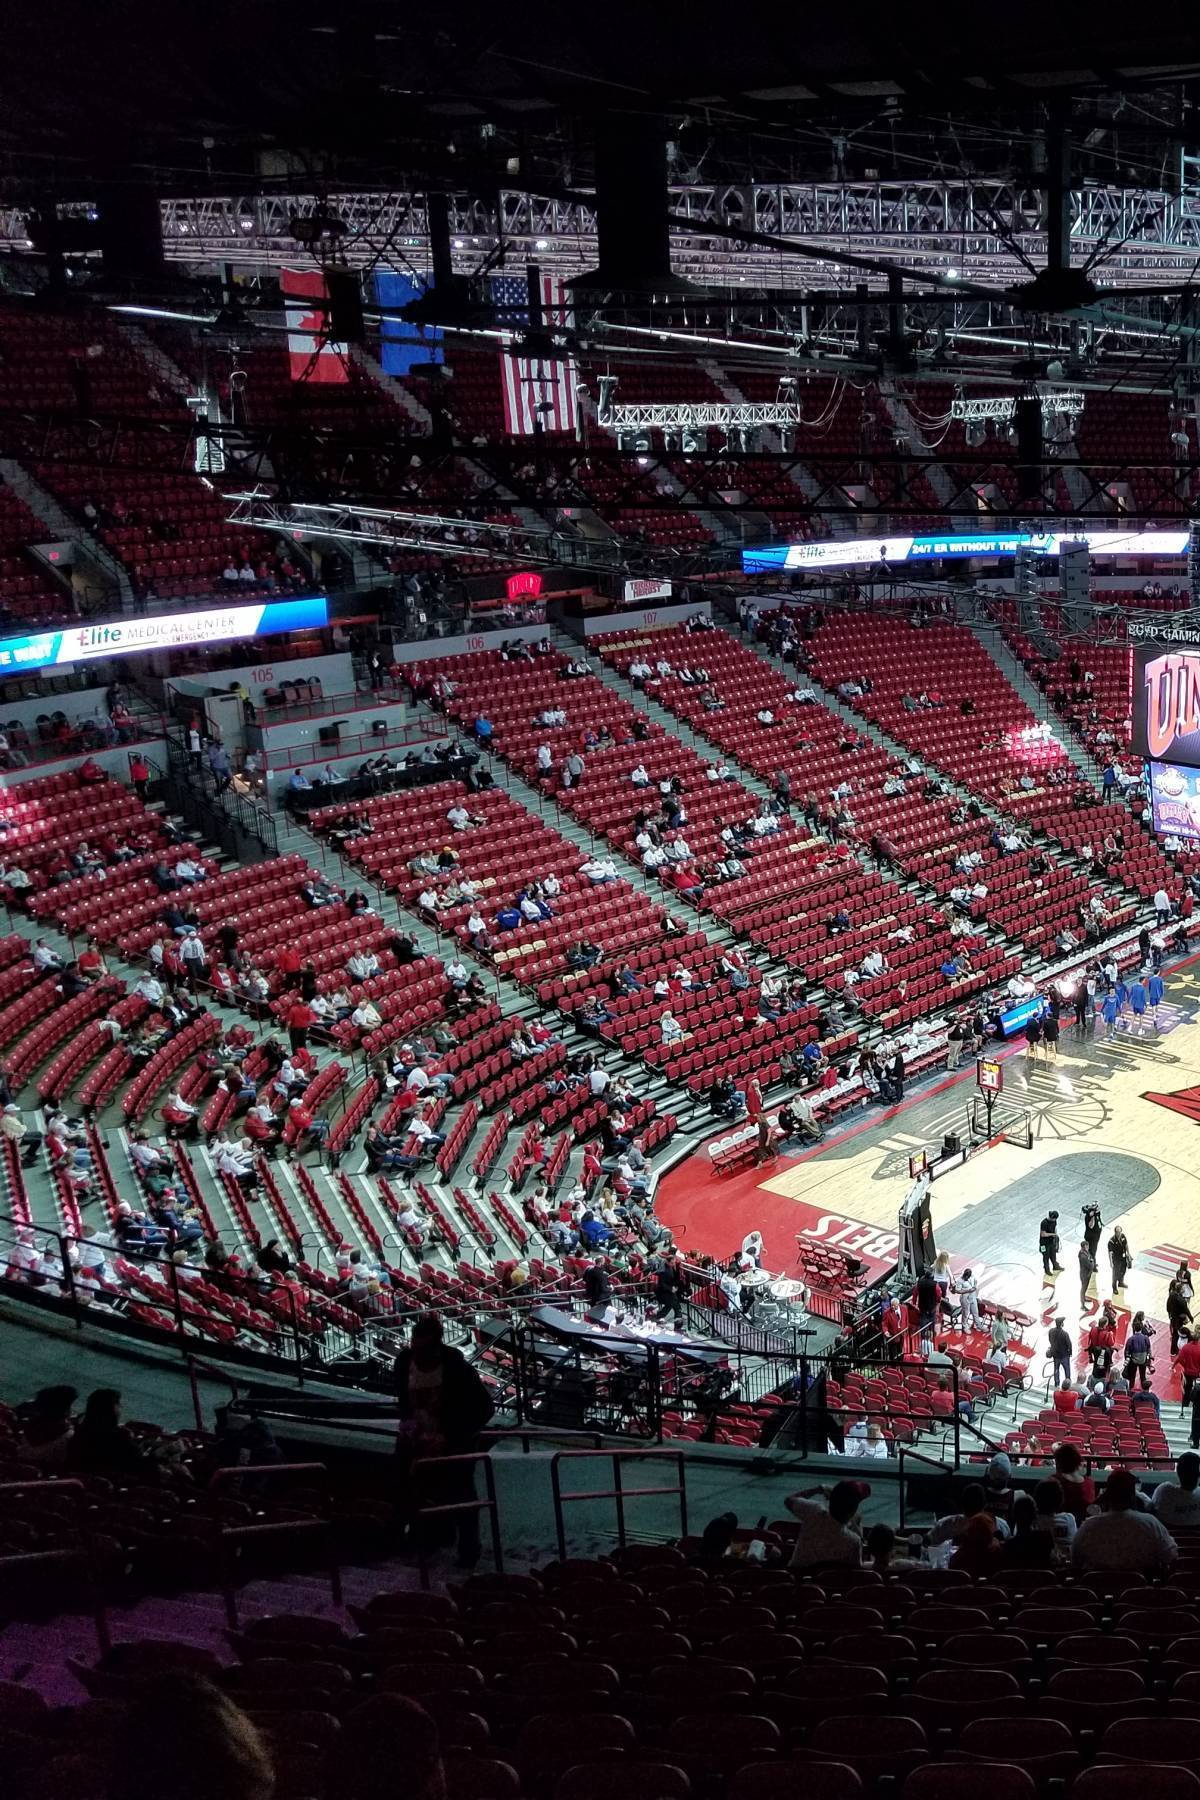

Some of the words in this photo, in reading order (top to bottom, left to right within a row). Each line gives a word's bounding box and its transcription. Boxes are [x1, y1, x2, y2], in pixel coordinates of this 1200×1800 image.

[912, 544, 931, 554] 24/7
[934, 543, 948, 553] ER
[949, 542, 996, 552] WITHOUT
[507, 571, 543, 600] UNLV
[643, 611, 657, 625] 107
[77, 626, 123, 647] Elite
[127, 622, 185, 640] MEDICAL
[186, 615, 236, 632] CENTER
[465, 637, 485, 651] 106
[251, 668, 273, 684] 105
